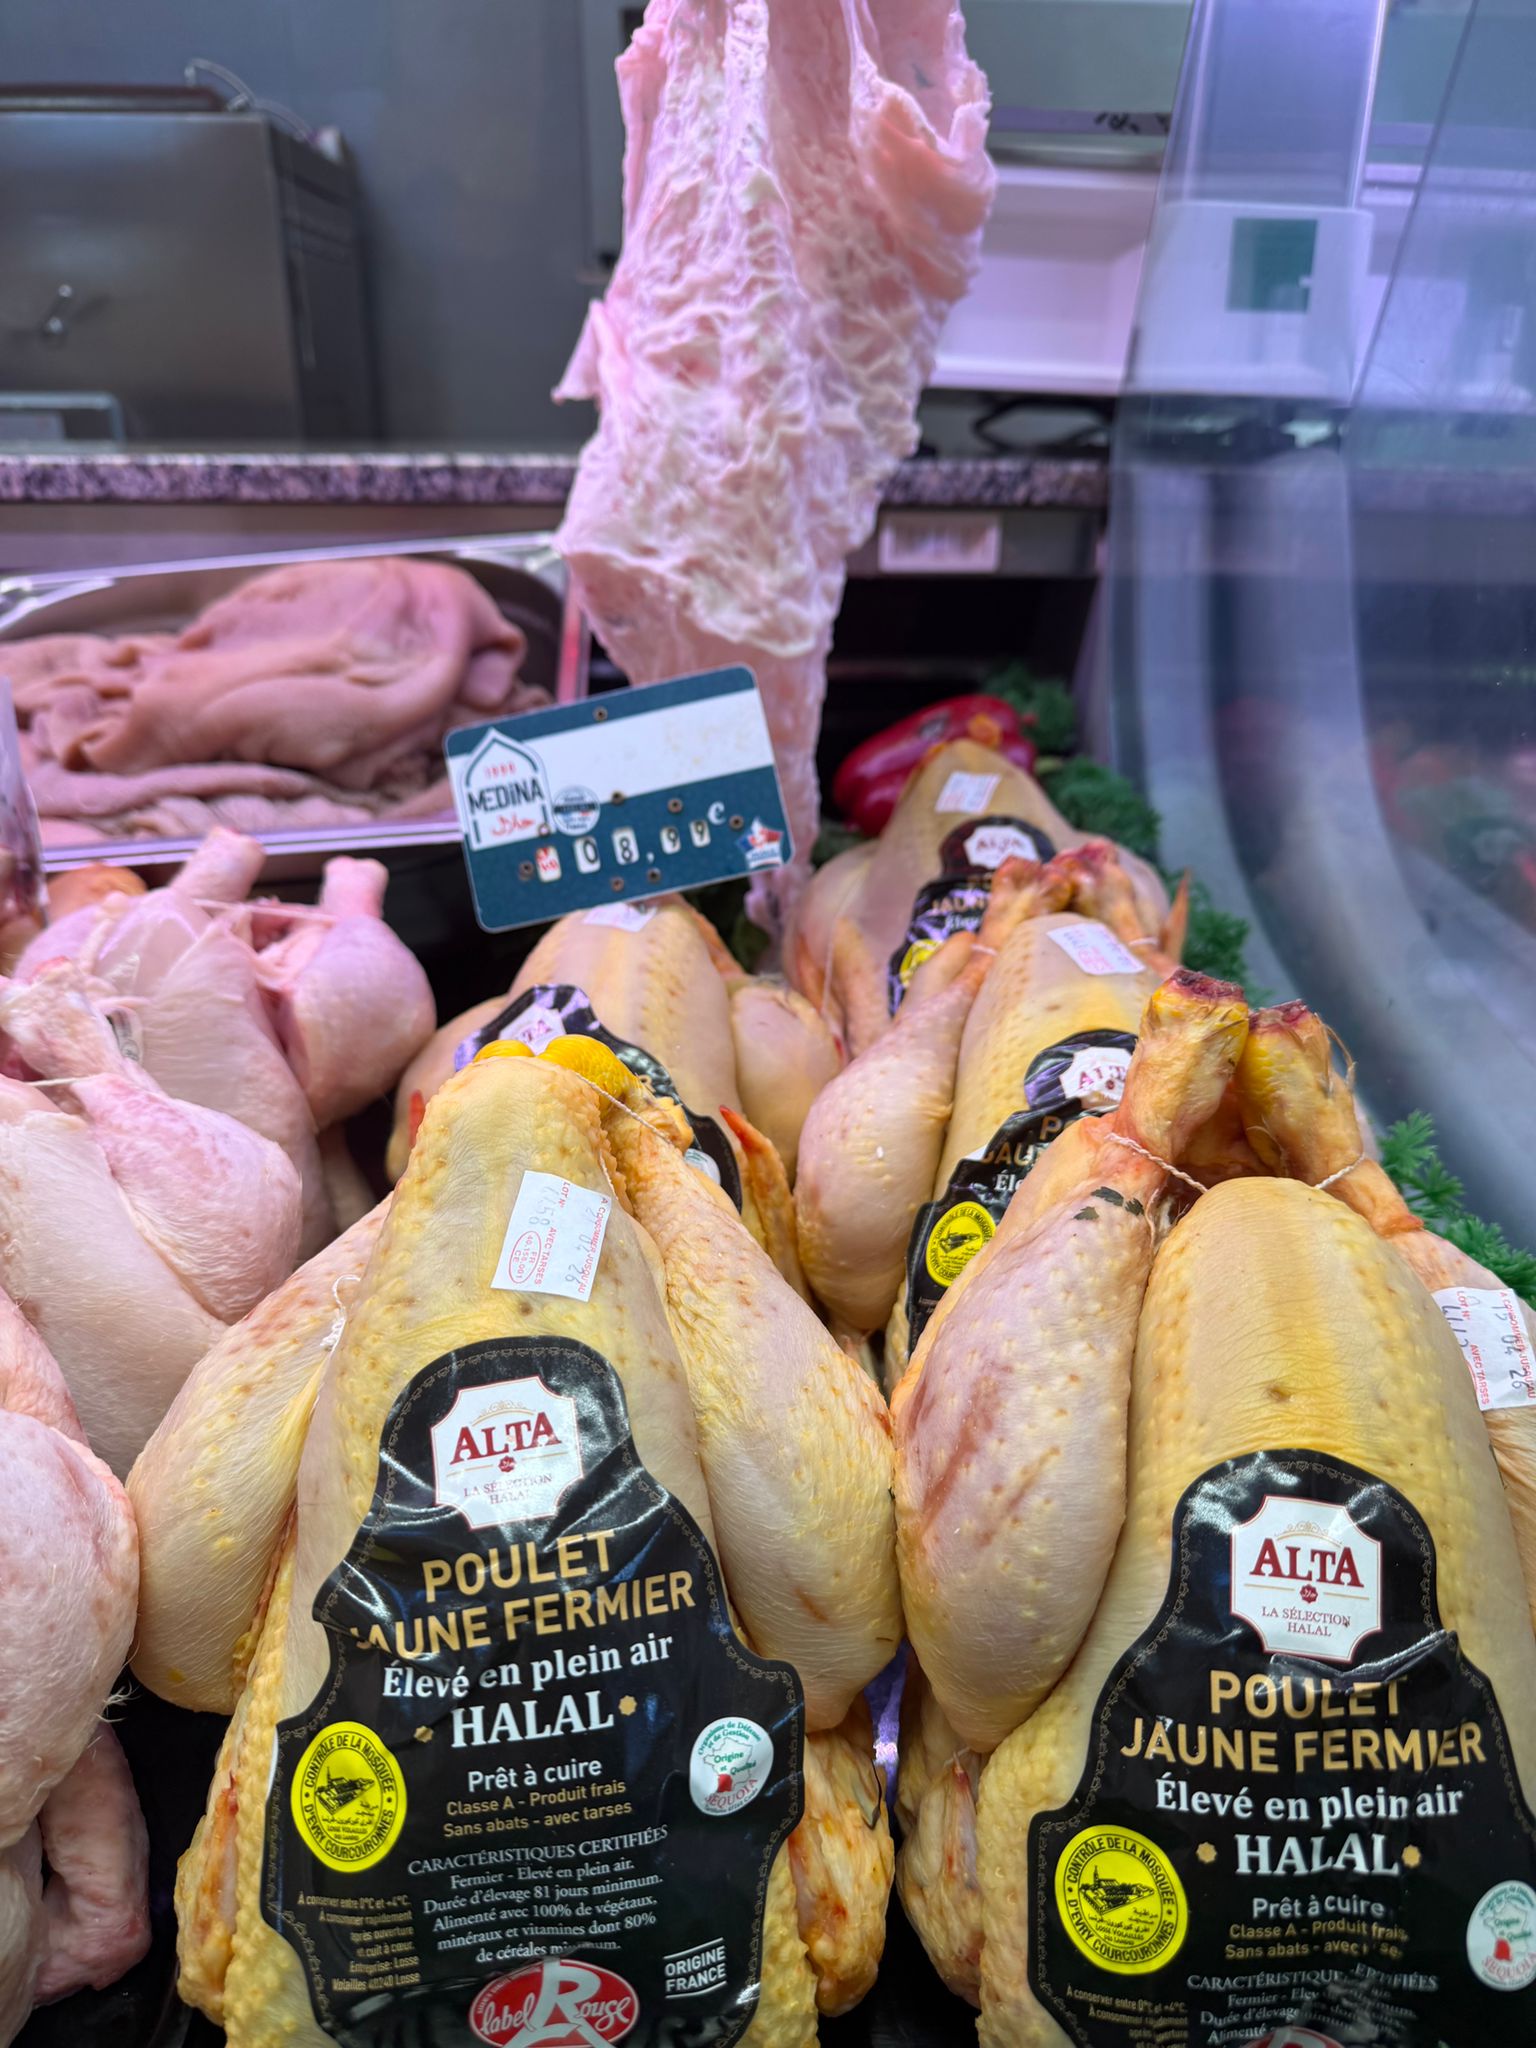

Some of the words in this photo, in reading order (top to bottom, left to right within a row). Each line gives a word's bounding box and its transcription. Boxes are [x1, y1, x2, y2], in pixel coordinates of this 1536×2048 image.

[544, 1226, 558, 1250] AVEC
[534, 1250, 552, 1285] TARSES
[1470, 1344, 1482, 1369] AVEC
[1476, 1370, 1490, 1405] TARSES
[449, 1411, 562, 1465] ALTA
[422, 1529, 616, 1603] POULET
[1249, 1537, 1365, 1588] ALTA
[504, 1569, 696, 1641] FERMIER
[1262, 1606, 1279, 1618] LA
[1282, 1606, 1351, 1628] SÉLECTION
[1287, 1622, 1332, 1637] HALAL
[382, 1659, 470, 1699] Élevé
[479, 1662, 521, 1689] en
[530, 1644, 627, 1692] plein
[629, 1632, 674, 1667] air
[1210, 1669, 1408, 1720] POULET
[451, 1690, 615, 1749] HALAL
[305, 1737, 335, 1788] CONTRÔLE
[336, 1734, 350, 1748] DE
[350, 1735, 362, 1749] LA
[361, 1743, 396, 1794] MOSQUÉE
[713, 1751, 744, 1763] Origine
[1120, 1717, 1279, 1773] JAUNE
[1295, 1721, 1488, 1773] FERMIER
[467, 1767, 518, 1793] Prêt
[523, 1762, 538, 1786] à
[544, 1758, 603, 1783] cuire
[446, 1800, 499, 1816] Classe
[502, 1795, 515, 1811] A
[529, 1786, 588, 1807] Produit
[590, 1779, 627, 1798] frais
[1155, 1772, 1253, 1818] Élevé
[1264, 1795, 1310, 1821] en
[1320, 1785, 1409, 1829] plein
[1415, 1783, 1464, 1818] air
[443, 1822, 482, 1838] Sans
[485, 1816, 529, 1832] abats
[544, 1809, 580, 1826] avec
[583, 1800, 633, 1821] tarses
[407, 1843, 576, 1875] CARACTÉRISTIQUES
[578, 1824, 668, 1856] CERTIFIÉES
[1234, 1832, 1400, 1876] HALAL
[450, 1870, 504, 1890] Fermier
[556, 1867, 573, 1879] en
[576, 1860, 612, 1881] plein
[613, 1856, 635, 1872] air.
[1067, 1838, 1105, 1883] CONTRÔLE
[1107, 1837, 1121, 1849] DE
[1123, 1839, 1138, 1854] LA
[1139, 1849, 1175, 1905] MOSQUÉE
[423, 1895, 467, 1914] Durée
[533, 1884, 550, 1899] 81
[554, 1884, 589, 1902] jours
[592, 1873, 663, 1896] minimum.
[1252, 1895, 1301, 1919] Prêt
[1307, 1894, 1321, 1918] à
[1324, 1894, 1385, 1918] cuire
[433, 1907, 497, 1932] Alimenté
[499, 1907, 529, 1920] avec
[533, 1903, 572, 1918] 100%
[575, 1902, 592, 1916] de
[437, 1930, 503, 1951] minéraux
[505, 1926, 519, 1938] et
[521, 1922, 586, 1936] vitamines
[588, 1920, 622, 1935] dont
[624, 1911, 657, 1930] 80%
[1067, 1898, 1094, 1941] D'EVRY
[1229, 1923, 1282, 1940] Classe
[1284, 1922, 1297, 1937] A
[1312, 1917, 1368, 1935] Produit
[475, 1947, 493, 1963] de
[495, 1941, 547, 1960] céréales
[664, 1944, 726, 1977] ORIGINE
[1092, 1919, 1175, 1962] COURCOURONNES
[1225, 1943, 1263, 1960] Sans
[1267, 1941, 1310, 1957] abats
[1324, 1939, 1359, 1953] avec
[665, 1962, 727, 1992] FRANCE
[478, 1991, 537, 2037] label
